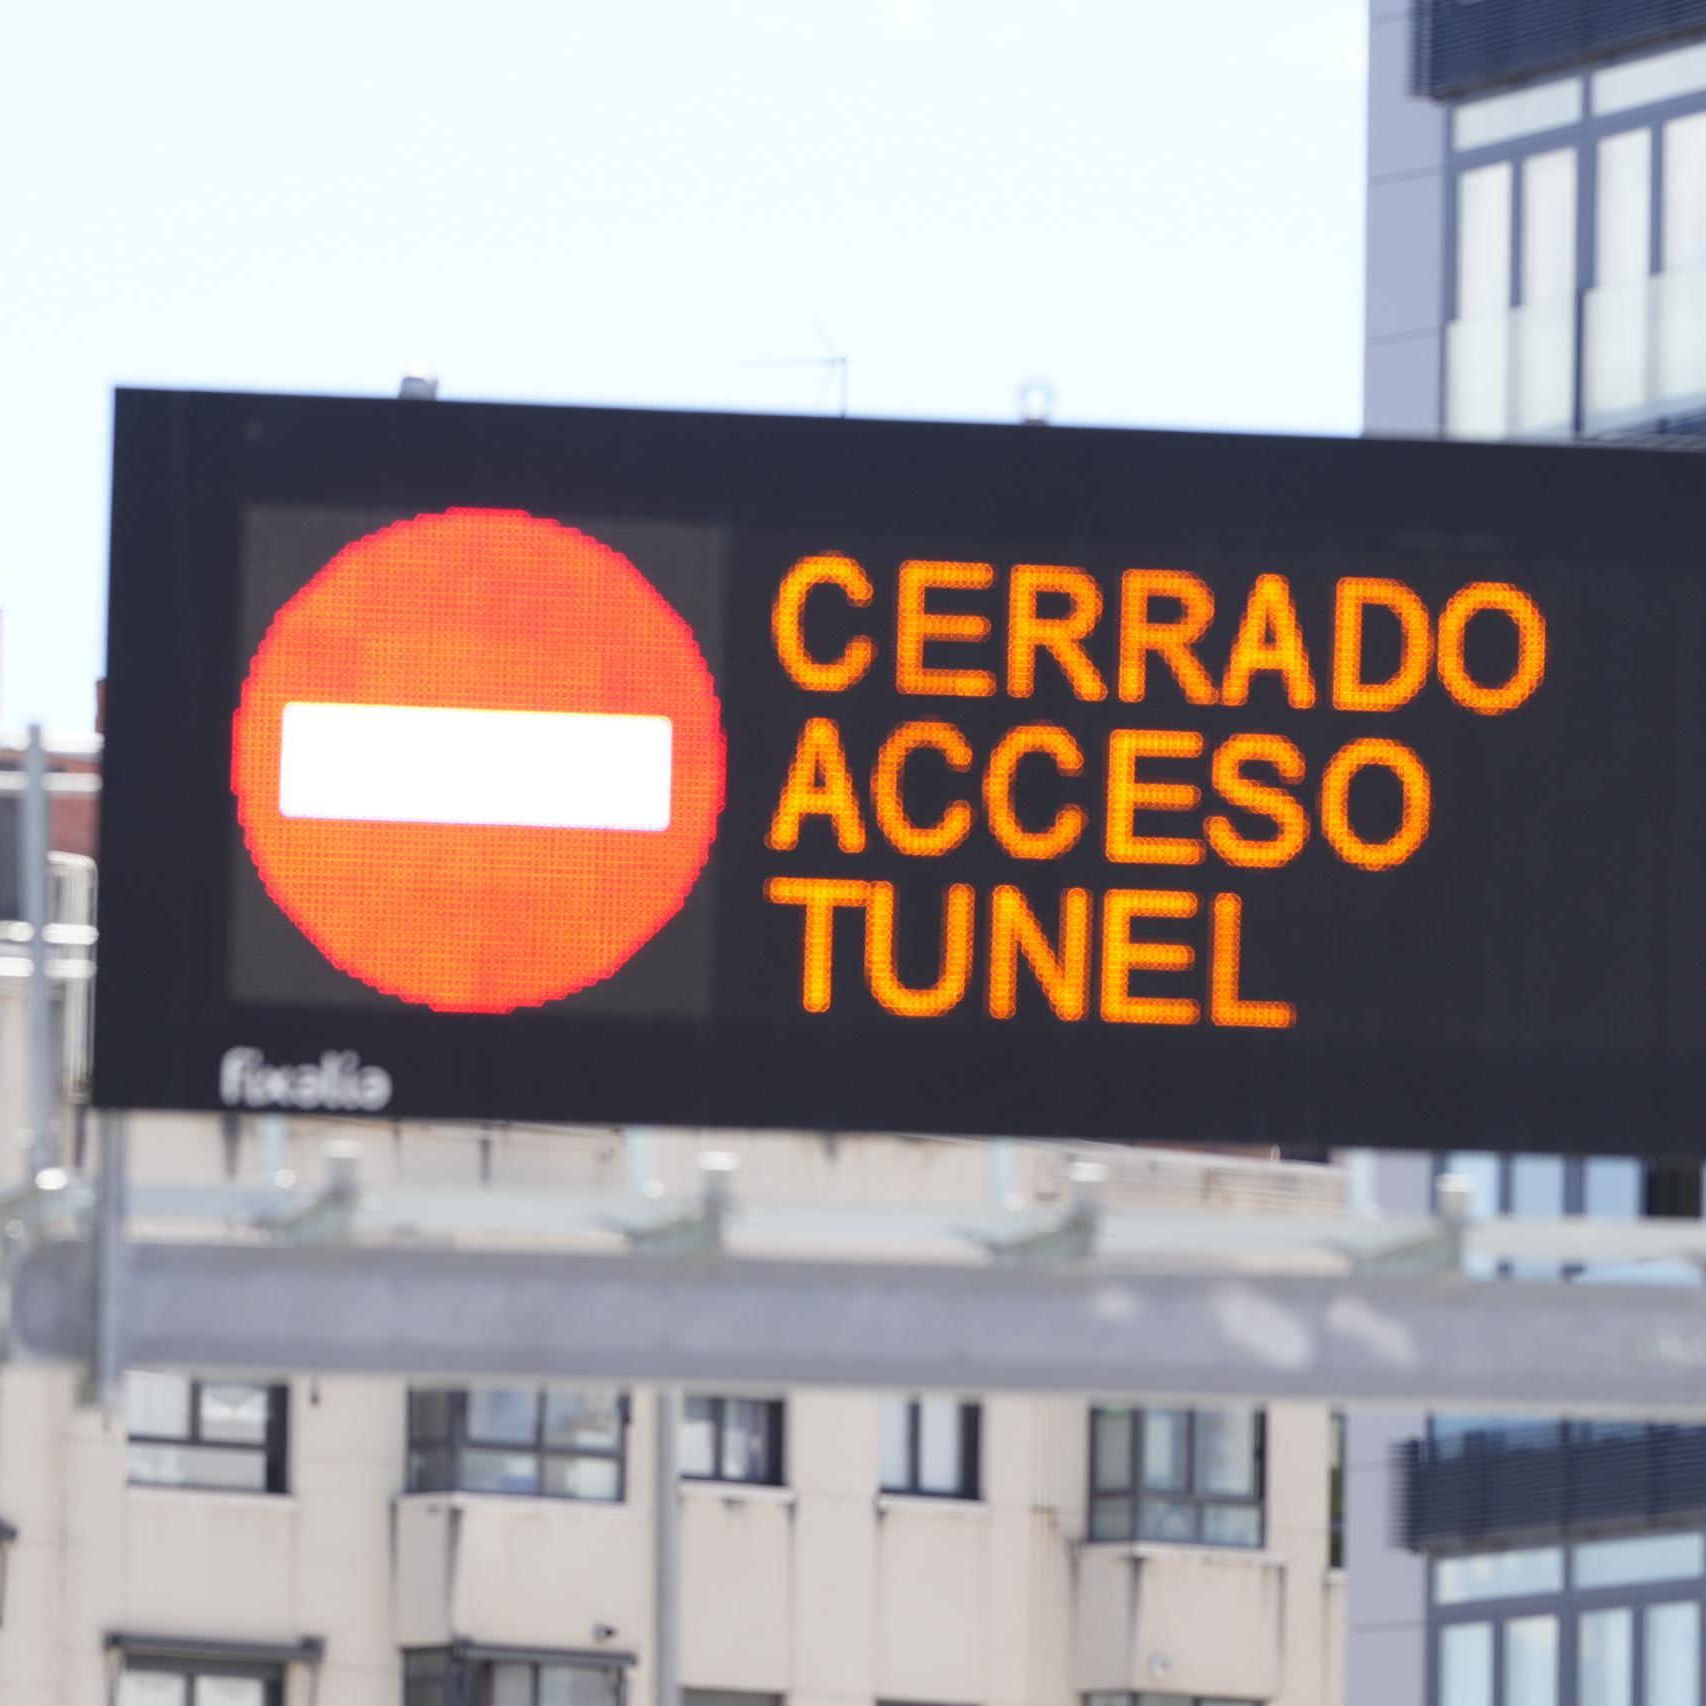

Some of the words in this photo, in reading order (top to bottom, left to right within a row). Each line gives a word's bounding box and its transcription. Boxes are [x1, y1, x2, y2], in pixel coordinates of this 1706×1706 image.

[771, 551, 1546, 716] CERRADO
[765, 717, 1431, 871] ACCESO
[764, 877, 1296, 1028] TUNEL
